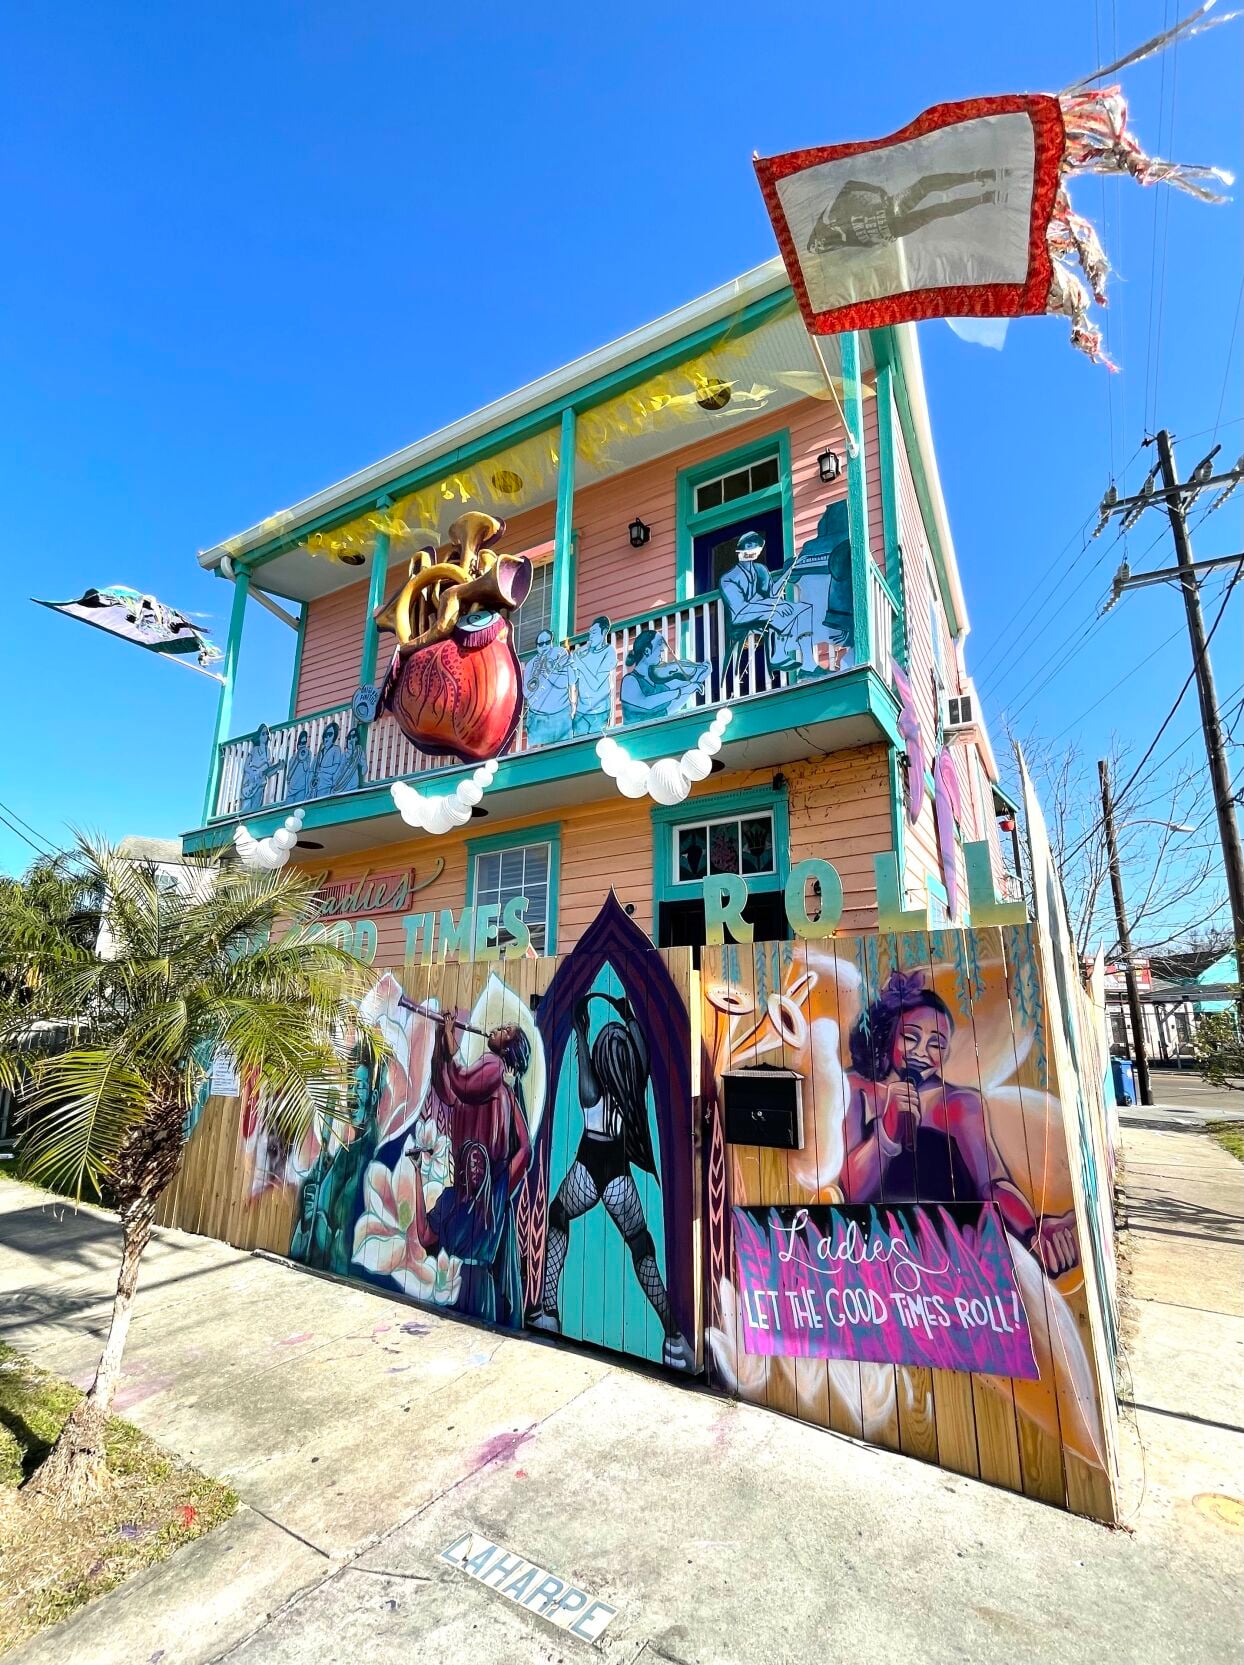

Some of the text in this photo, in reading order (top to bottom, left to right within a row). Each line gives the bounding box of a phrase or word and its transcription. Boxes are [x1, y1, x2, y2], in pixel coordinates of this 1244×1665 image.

[282, 839, 1027, 969] OD TIMES ROLL
[743, 1289, 783, 1331] LET
[784, 1286, 824, 1329] THE
[825, 1288, 888, 1328] GOOD
[953, 1290, 1021, 1334] ROLL!
[440, 1532, 618, 1642] LAHARPE
